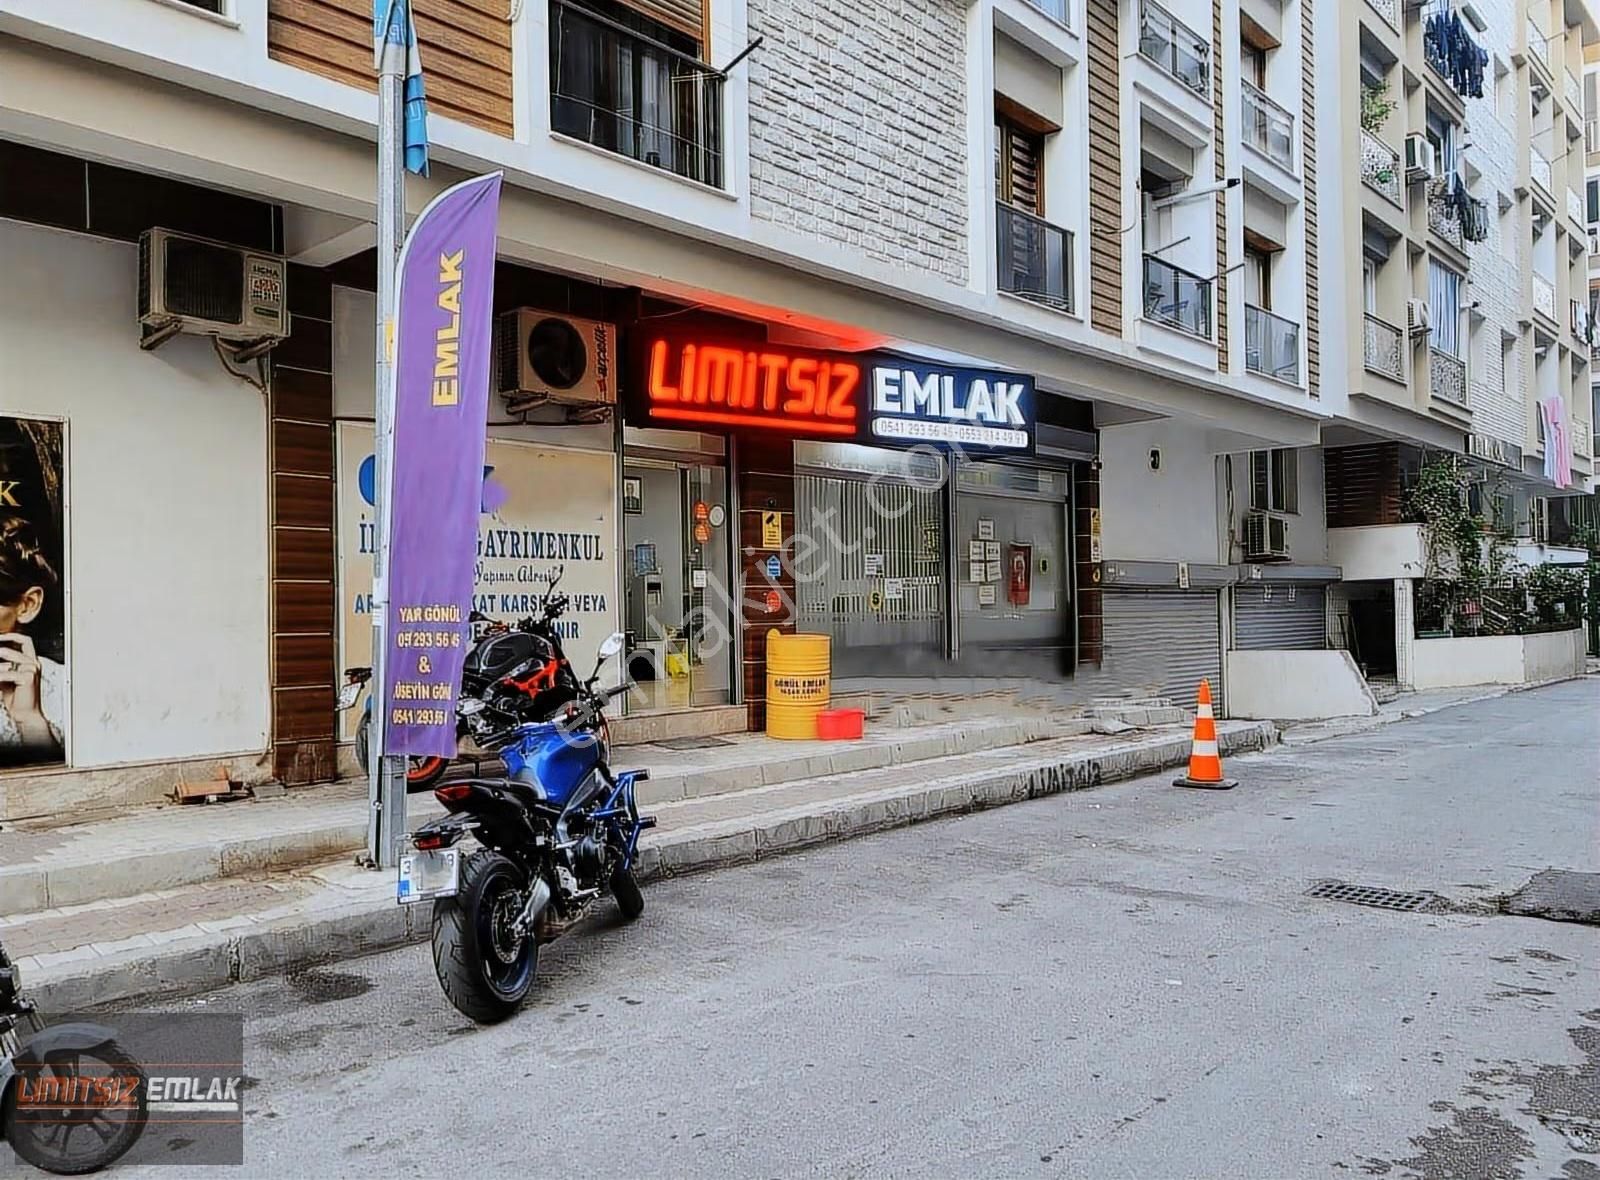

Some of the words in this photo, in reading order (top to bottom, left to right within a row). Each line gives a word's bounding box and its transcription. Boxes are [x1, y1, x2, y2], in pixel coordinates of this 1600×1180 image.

[432, 248, 465, 407] EMLAK
[872, 367, 1026, 424] EMLAK
[880, 420, 905, 434] 0541
[908, 423, 926, 437] 293
[575, 595, 607, 612] VEYA
[424, 604, 461, 623] GÖNÜL
[413, 632, 433, 648] 293
[436, 632, 450, 648] 56
[418, 655, 431, 673] &
[393, 681, 430, 700] ÜSEYİN
